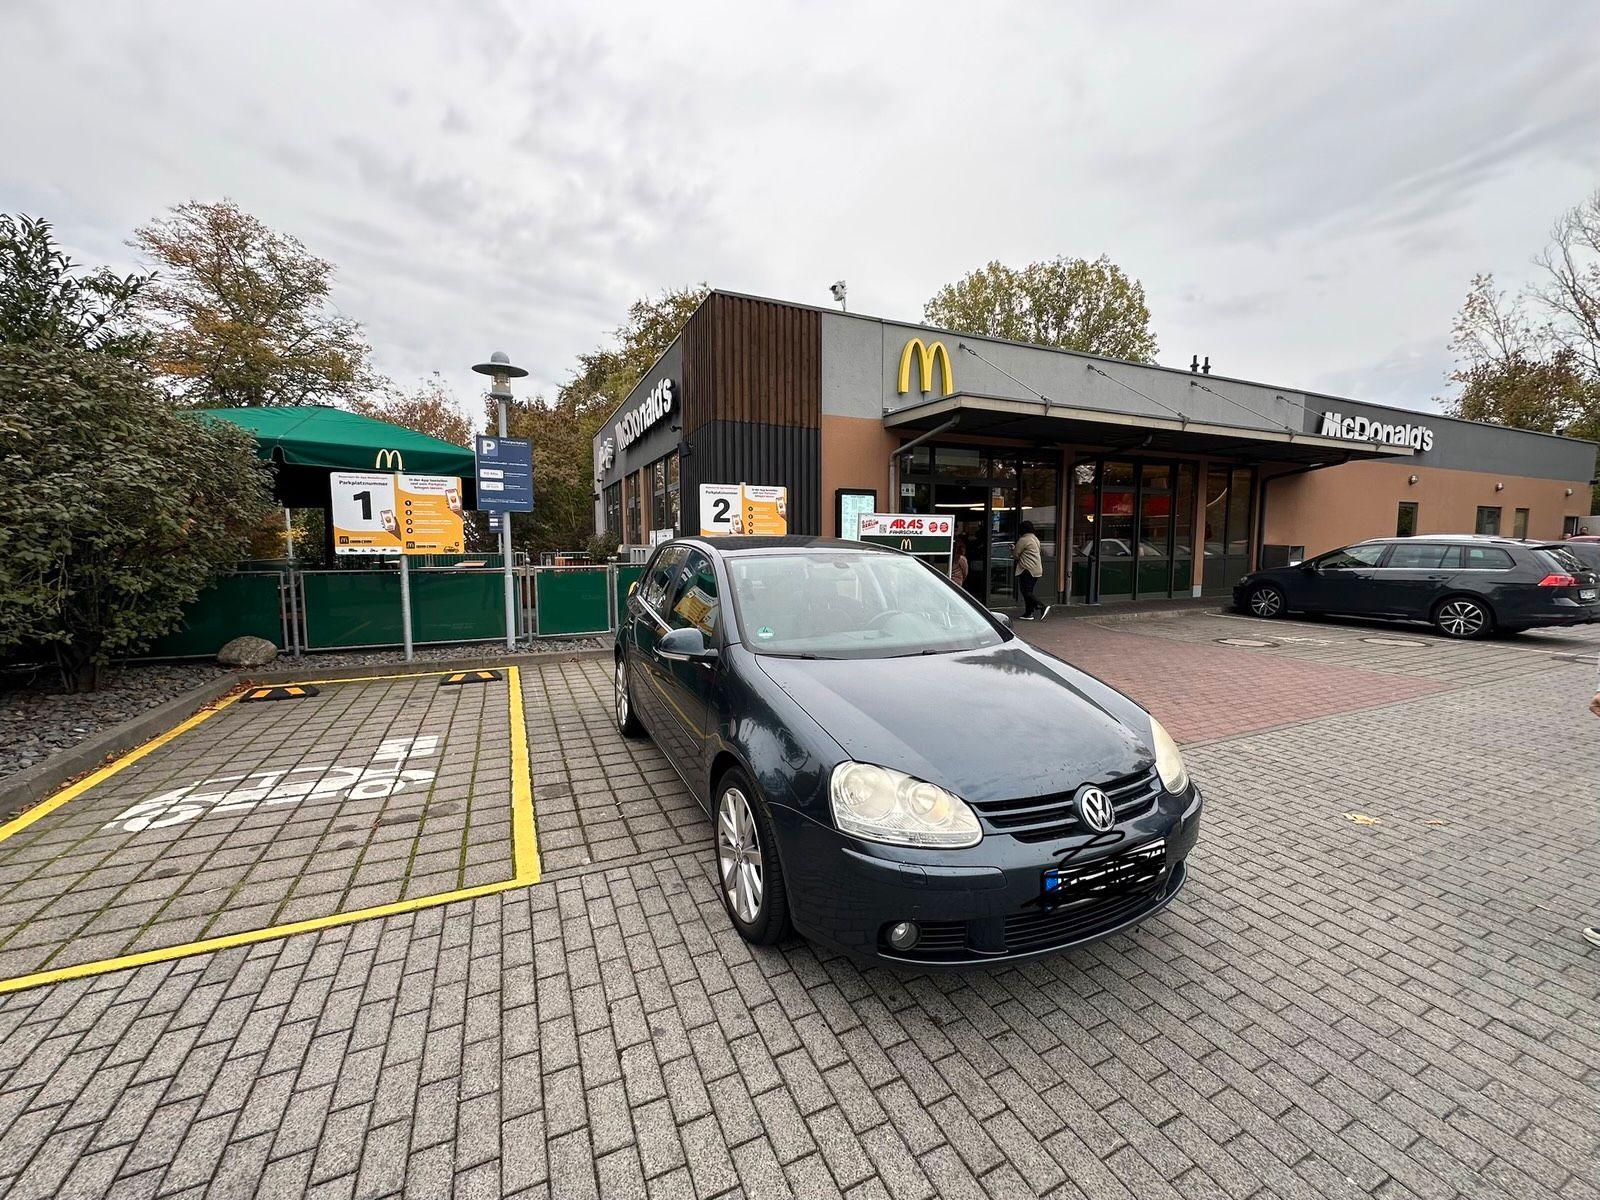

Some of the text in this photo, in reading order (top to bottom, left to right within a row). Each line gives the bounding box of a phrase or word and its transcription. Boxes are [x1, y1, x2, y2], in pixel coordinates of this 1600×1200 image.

[615, 378, 672, 452] McDonald's
[1321, 411, 1434, 452] McDonald's
[482, 439, 496, 455] P
[353, 490, 372, 520] 1
[712, 498, 731, 523] 2
[889, 518, 924, 530] ARAS
